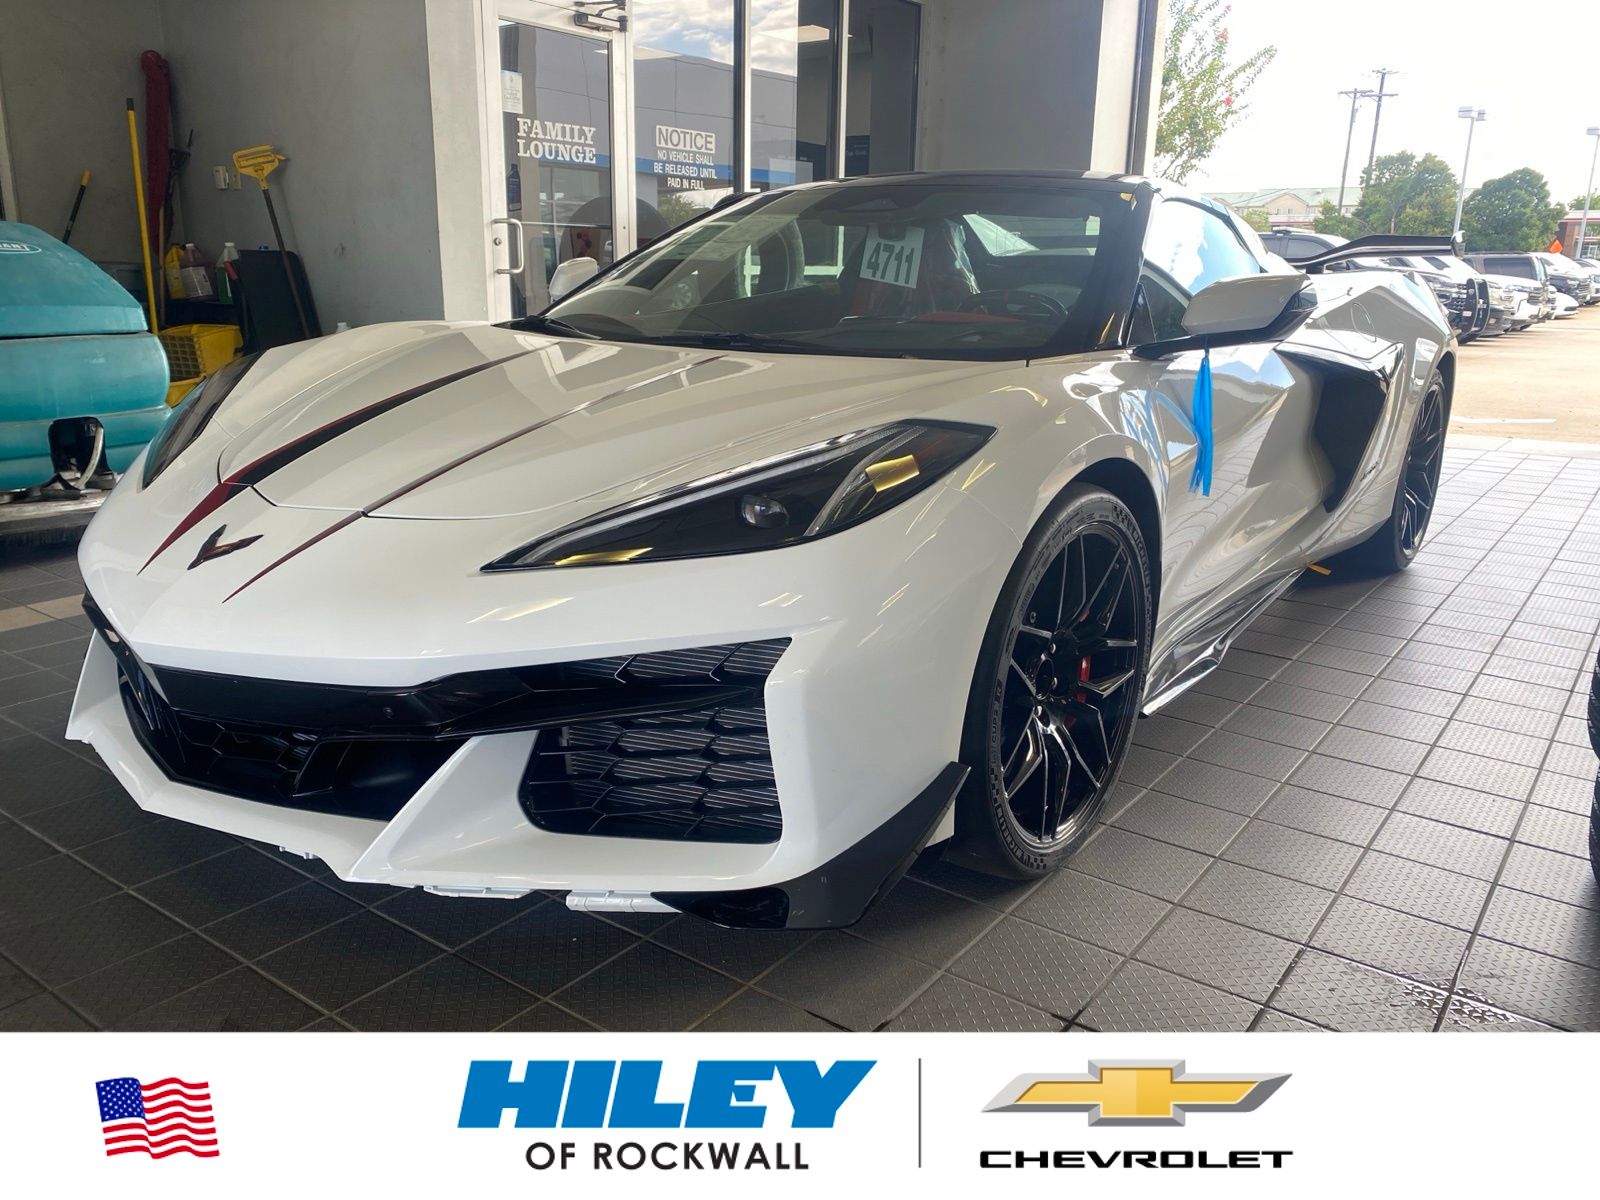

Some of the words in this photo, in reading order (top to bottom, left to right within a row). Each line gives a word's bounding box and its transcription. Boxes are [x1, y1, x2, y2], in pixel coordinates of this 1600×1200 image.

[516, 117, 596, 145] FAMILY
[658, 127, 714, 152] NOTICE
[516, 138, 596, 164] LOUNGE
[657, 150, 667, 160] NO
[669, 151, 694, 164] VEHICLE
[695, 154, 714, 166] SHALL
[653, 162, 663, 173] BE
[665, 163, 698, 177] RELEASED
[699, 167, 717, 179] UNTIL
[667, 177, 681, 188] PAID
[682, 178, 689, 189] IN
[690, 179, 705, 190] FULL
[866, 241, 915, 285] 4711
